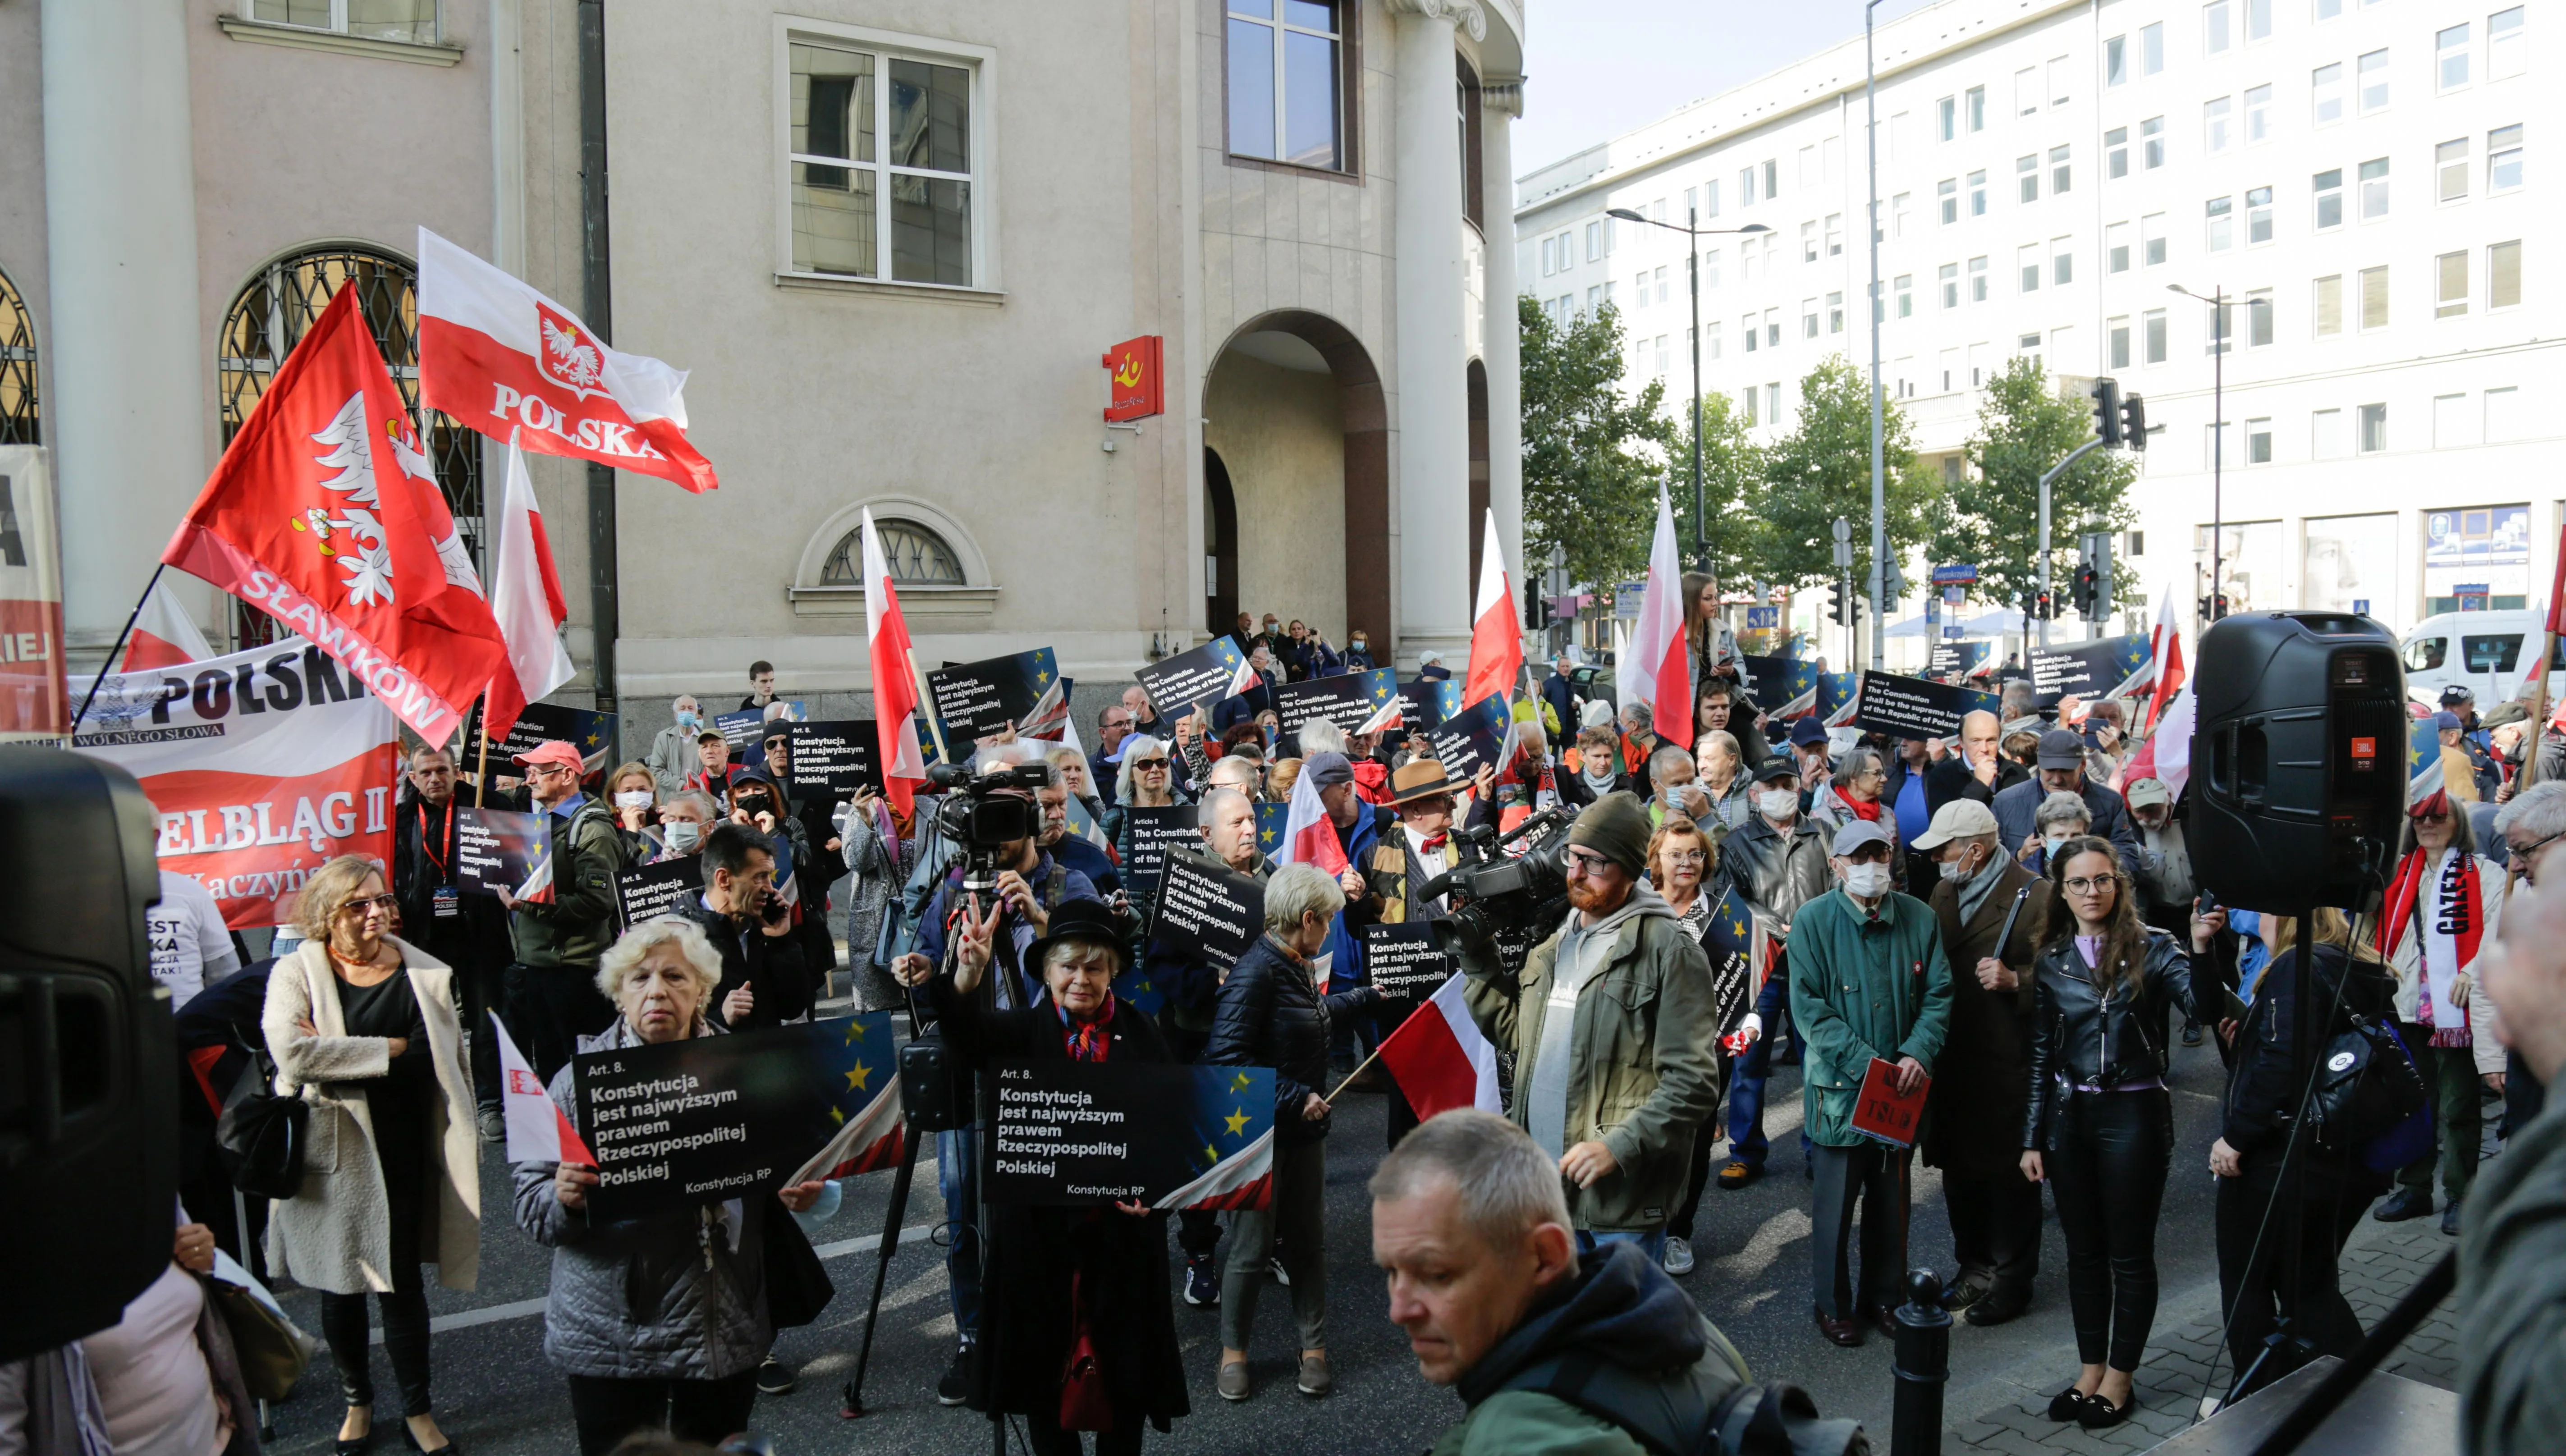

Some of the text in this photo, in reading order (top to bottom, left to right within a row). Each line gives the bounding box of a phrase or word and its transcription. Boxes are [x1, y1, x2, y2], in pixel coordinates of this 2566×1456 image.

[490, 382, 668, 462] POLSKA
[243, 570, 446, 730] SŁAWKÓW
[2032, 655, 2071, 665] Konstytucja
[2033, 661, 2086, 673] jest najwyższym
[935, 678, 978, 692] Konstytucja
[1153, 689, 1168, 698] shall
[1187, 672, 1212, 684] supreme
[1211, 666, 1223, 674] law
[1159, 668, 1195, 686] Constitution
[2035, 673, 2090, 686] Rzeczypospolitej
[938, 684, 994, 703] jest najwyższym
[1175, 685, 1201, 699] Republic
[1208, 673, 1229, 685] Poland
[2036, 686, 2062, 695] Polskiej
[1295, 694, 1338, 705] Constitution
[1868, 686, 1929, 704] The Constitution
[940, 699, 970, 711] prawem
[942, 699, 1001, 718] Rzeczypospolitej
[1282, 709, 1298, 718] shall
[1324, 701, 1355, 710] supreme
[1347, 706, 1371, 716] Poland
[1865, 696, 1883, 705] shall
[1911, 705, 1945, 716] supreme
[1947, 711, 1961, 720] law
[719, 718, 749, 727] Konstytucja
[979, 722, 1006, 732] Konstytucja
[1888, 709, 1921, 721] Republic
[1932, 718, 1960, 729] Poland
[77, 725, 222, 746] WOLNEGO SŁOWA
[793, 737, 845, 746] Konstytucja
[793, 746, 864, 756] jest najwyższym
[2357, 743, 2371, 752] JBL
[795, 764, 866, 773] Rzeczypospolitej
[795, 776, 828, 784] Polskiej
[158, 787, 388, 857] ELBLĄG II
[460, 824, 489, 837] Konstytucja
[460, 835, 500, 847] jest najwyższym
[1134, 829, 1150, 838] The
[1135, 842, 1156, 850] shall
[1146, 855, 1161, 863] the
[1173, 852, 1185, 861] Art.
[461, 866, 480, 878] Polskiej
[1172, 863, 1228, 895] Konstytucja
[624, 879, 683, 898] Konstytucja
[1168, 874, 1246, 914] jest najwyższym
[627, 897, 646, 911] jest
[1167, 887, 1207, 909] prawem
[629, 905, 670, 922] prawem
[1165, 896, 1245, 939] Rzeczypospolitej
[1162, 910, 1200, 935] Polskiej
[1370, 940, 1428, 953] Konstytucja
[1370, 953, 1388, 966] jest
[1724, 951, 1737, 970] law
[1371, 964, 1411, 976] prawem
[1720, 959, 1746, 1005] of Poland
[1719, 1011, 1732, 1031] REPUBLIC
[1733, 987, 1744, 1006] POLAND
[588, 1062, 626, 1076] Art. 8.
[1001, 1069, 1032, 1079] Art. 8.
[591, 1074, 699, 1103] Konstytucja
[1000, 1088, 1092, 1107] Konstytucja
[592, 1089, 737, 1127] jest najwyższym
[998, 1105, 1124, 1125] jest najwyższym
[595, 1120, 670, 1147] prawem
[998, 1125, 1062, 1138] prawem
[597, 1123, 746, 1163] Rzeczypospolitej
[997, 1139, 1127, 1159] Rzeczypospolitej
[600, 1161, 669, 1187] Polskiej
[996, 1160, 1055, 1178] Polskiej
[686, 1168, 772, 1194] Konstytucja RP
[1067, 1184, 1145, 1197] Konstytucja RP
